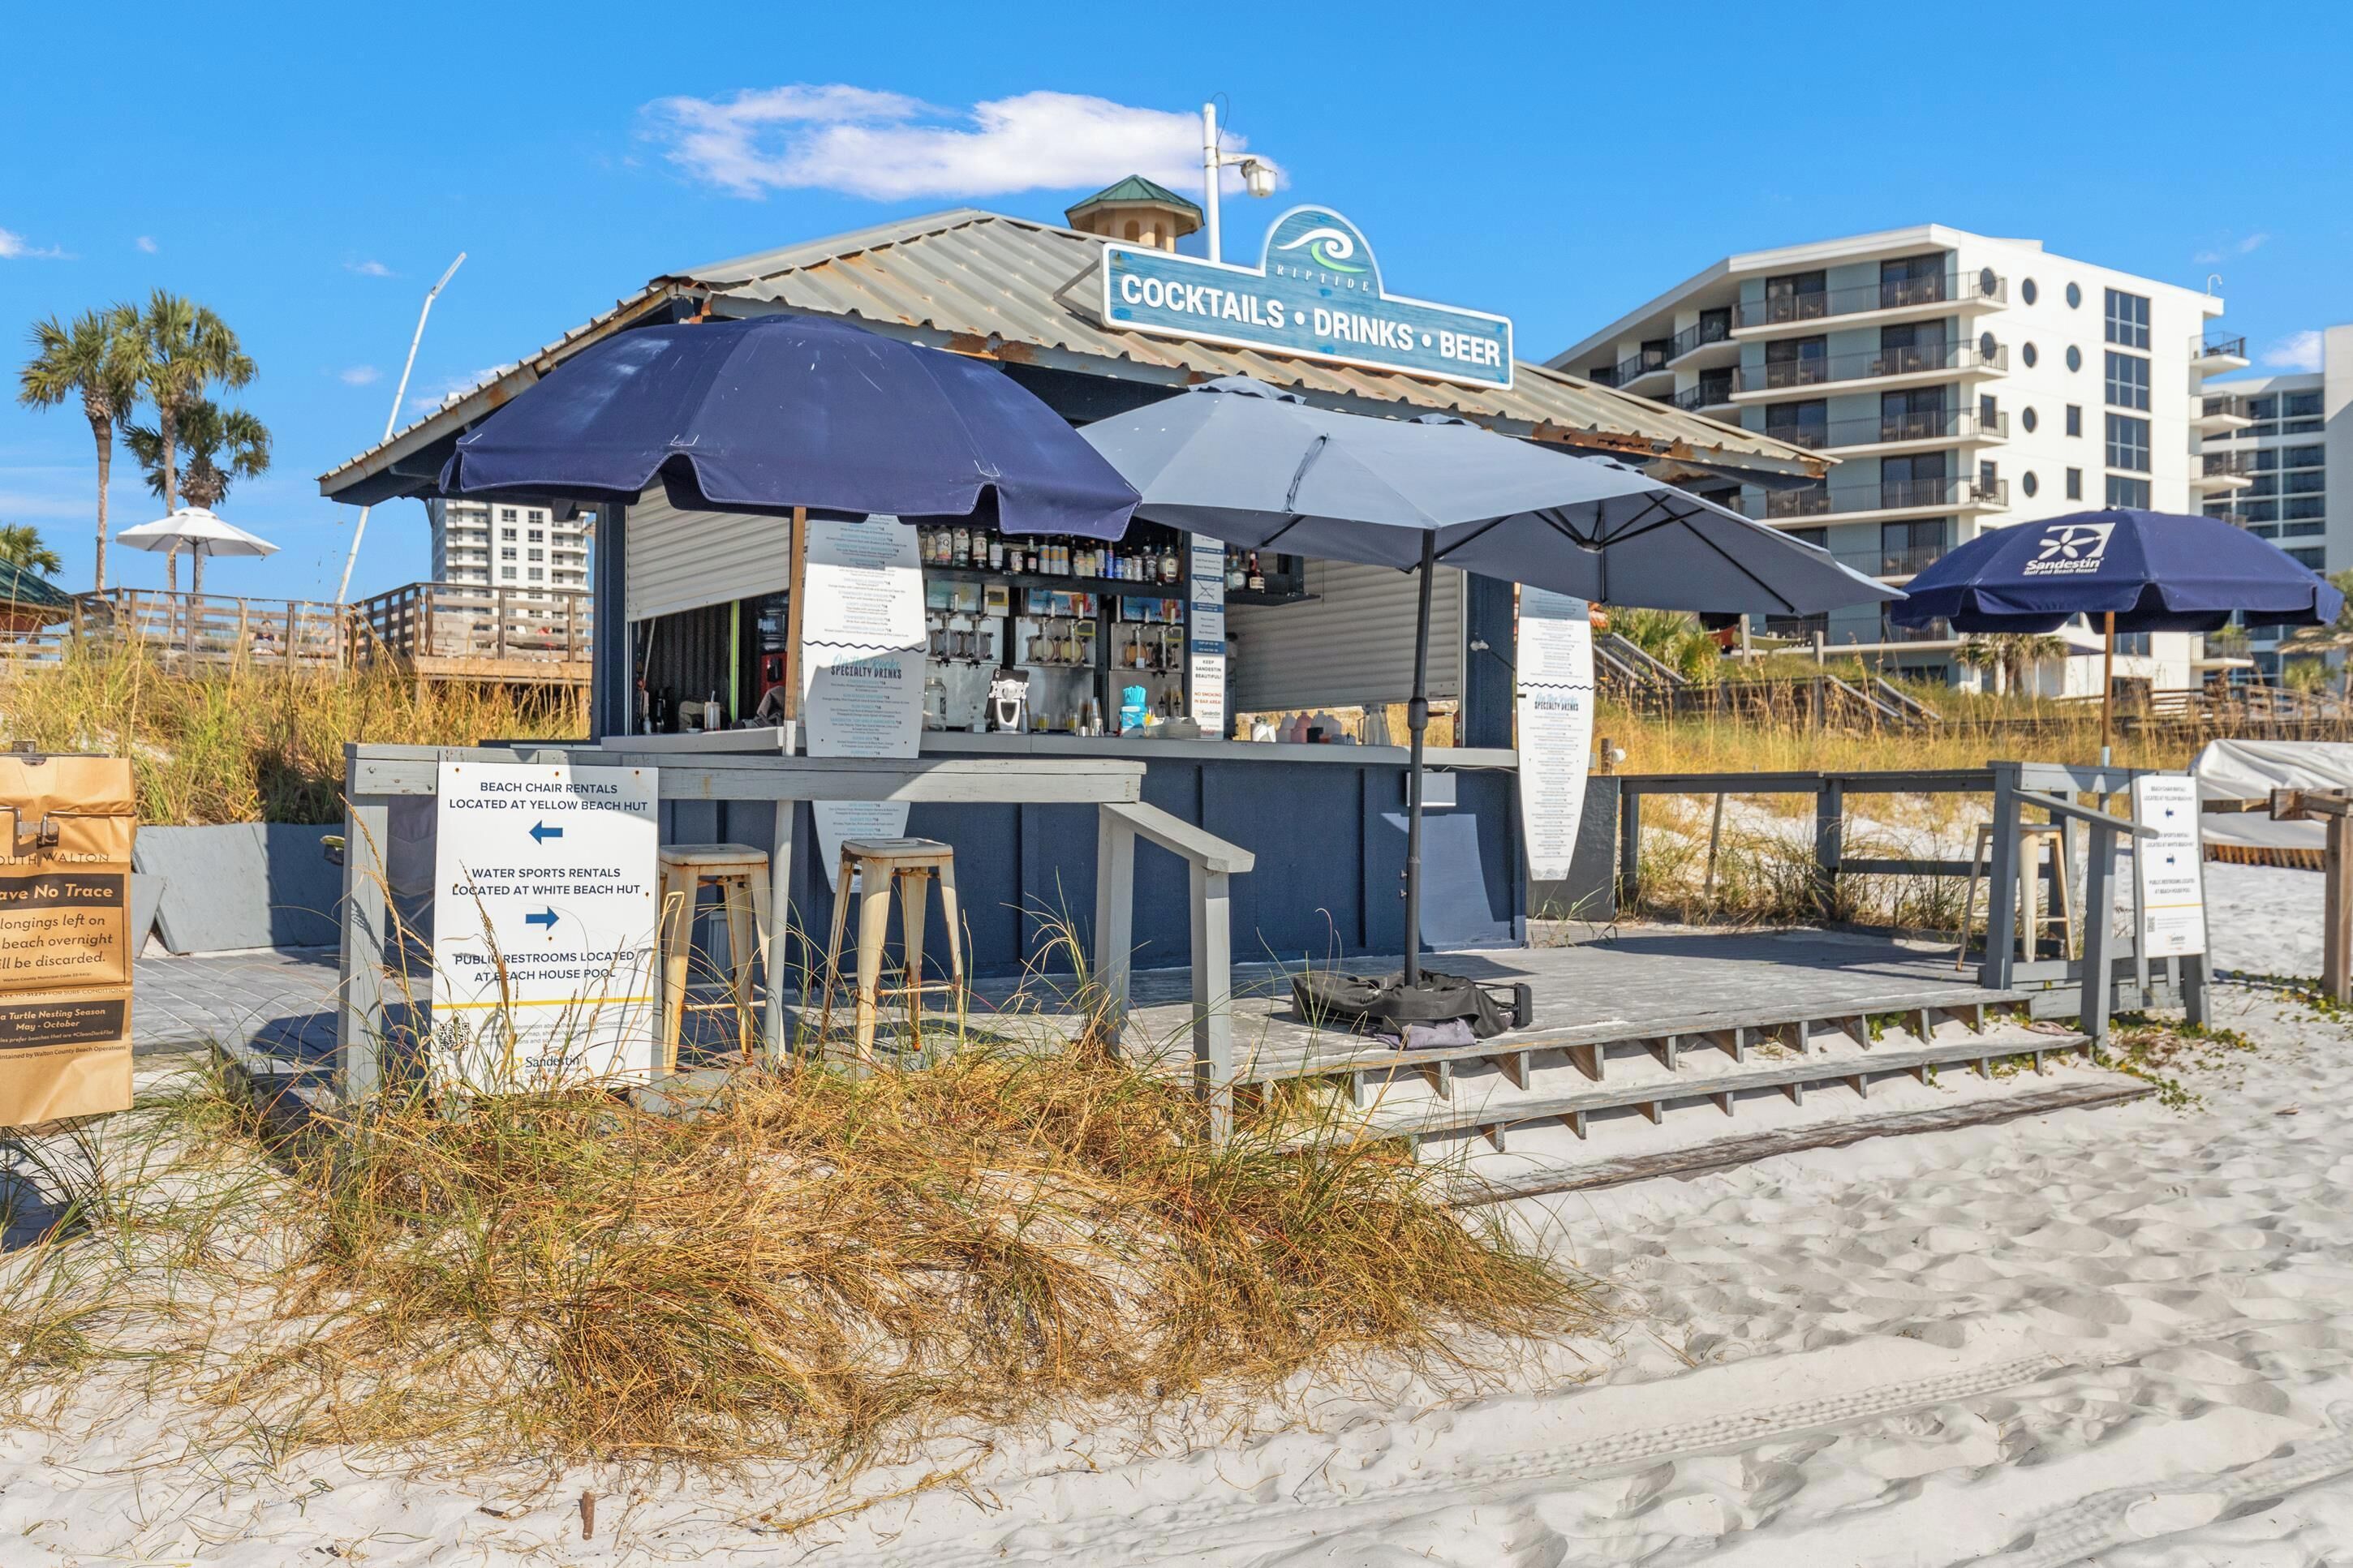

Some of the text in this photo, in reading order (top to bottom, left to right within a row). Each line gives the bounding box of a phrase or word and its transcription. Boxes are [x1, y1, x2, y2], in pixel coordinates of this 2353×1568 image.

[1276, 264, 1369, 292] RIPTIDE
[1121, 274, 1501, 367] COCKTAILS DRINKS BEER
[2024, 557, 2101, 570] Sandestin
[830, 664, 902, 680] SPECIALTY DRINKS
[480, 782, 617, 794] BEACH CHAIR RENTALS
[450, 799, 648, 811] LOCATED AT YELLOW BEACH HUT
[43, 853, 110, 863] WALTON
[471, 867, 621, 878] WATER SPORTS RENTALS
[33, 884, 59, 899] No
[65, 883, 114, 898] Trace
[452, 884, 640, 896] LOCATED AT WHITE BEACH HUT
[62, 913, 85, 928] left
[88, 917, 105, 926] on
[2, 933, 113, 949] beach overnight
[15, 956, 31, 969] be
[36, 951, 105, 967] discarded.
[503, 952, 577, 964] RESTROOMS
[580, 951, 634, 961] LOCATED
[475, 973, 490, 982] AT
[539, 969, 580, 979] HOUSE
[583, 969, 616, 978] POOL
[10, 1012, 37, 1020] Turtle
[39, 1010, 73, 1019] Nesting
[75, 1008, 105, 1016] Season
[15, 1023, 36, 1032] May
[43, 1020, 80, 1029] October
[9, 1036, 27, 1044] prefer
[54, 1048, 74, 1056] County
